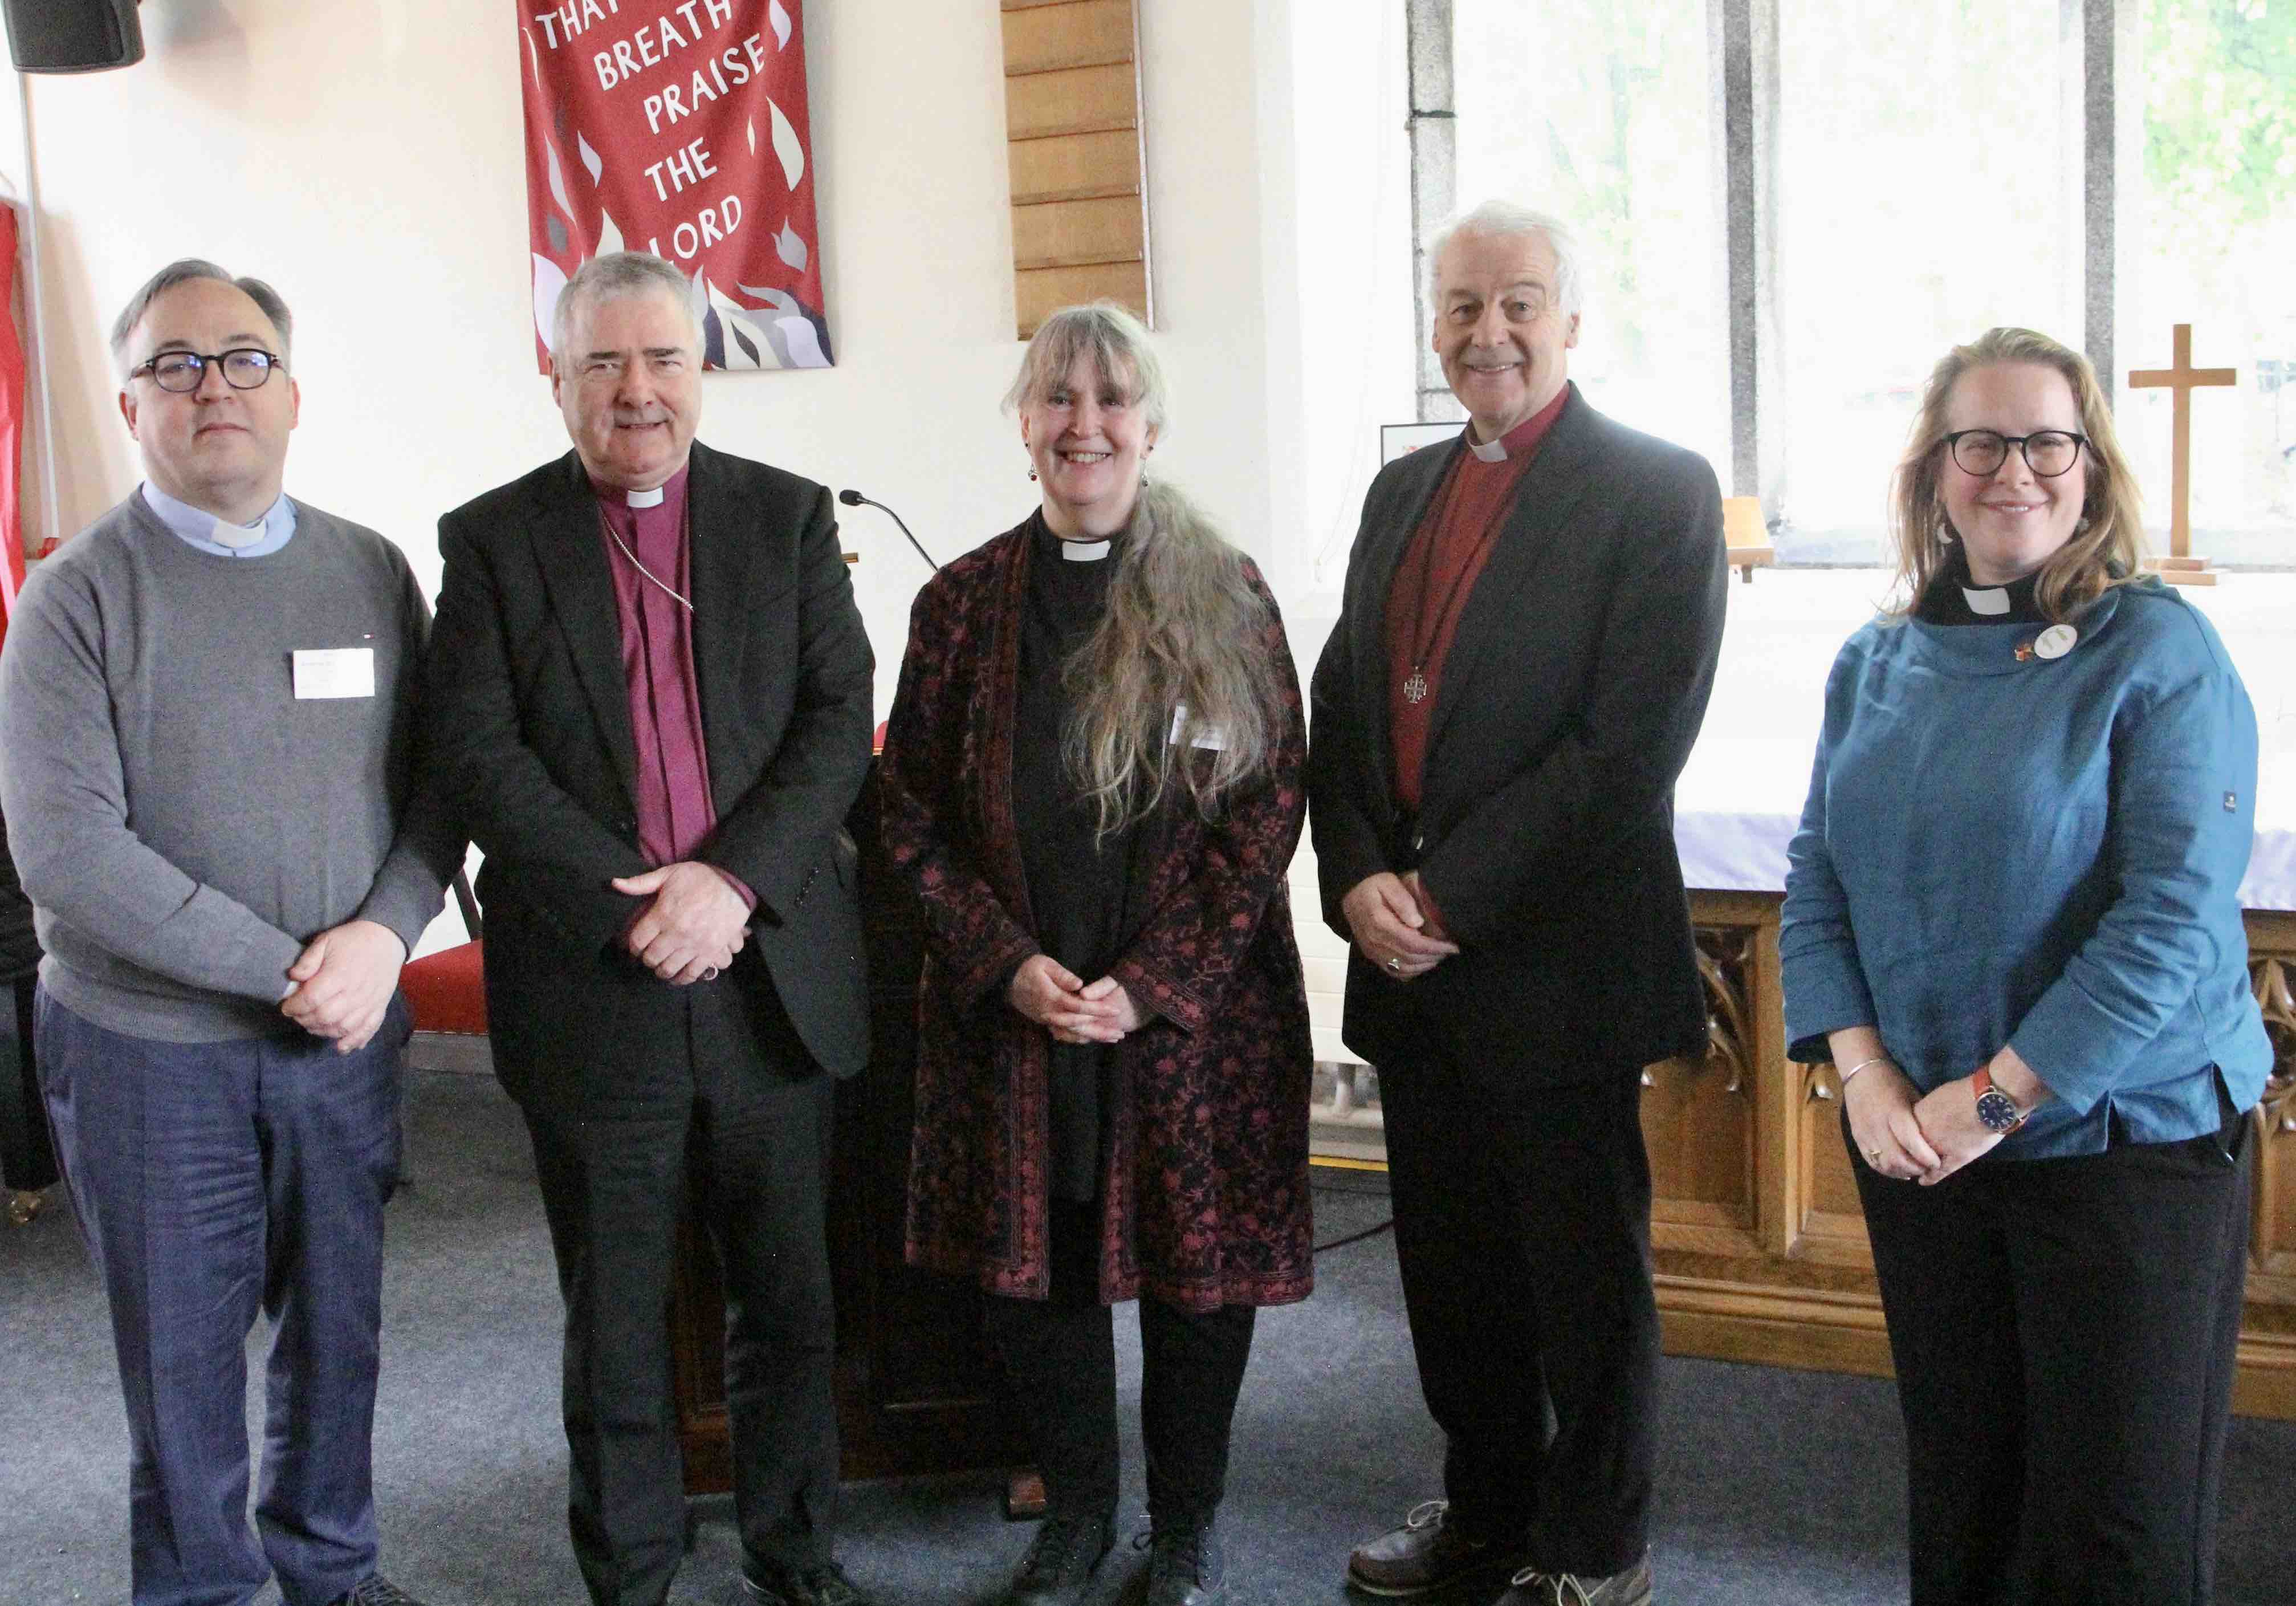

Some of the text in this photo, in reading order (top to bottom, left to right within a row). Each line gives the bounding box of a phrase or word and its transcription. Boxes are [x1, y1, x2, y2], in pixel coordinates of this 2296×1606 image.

[593, 0, 732, 91] BREATH
[644, 34, 766, 135] PRAISE
[645, 137, 717, 202] THE
